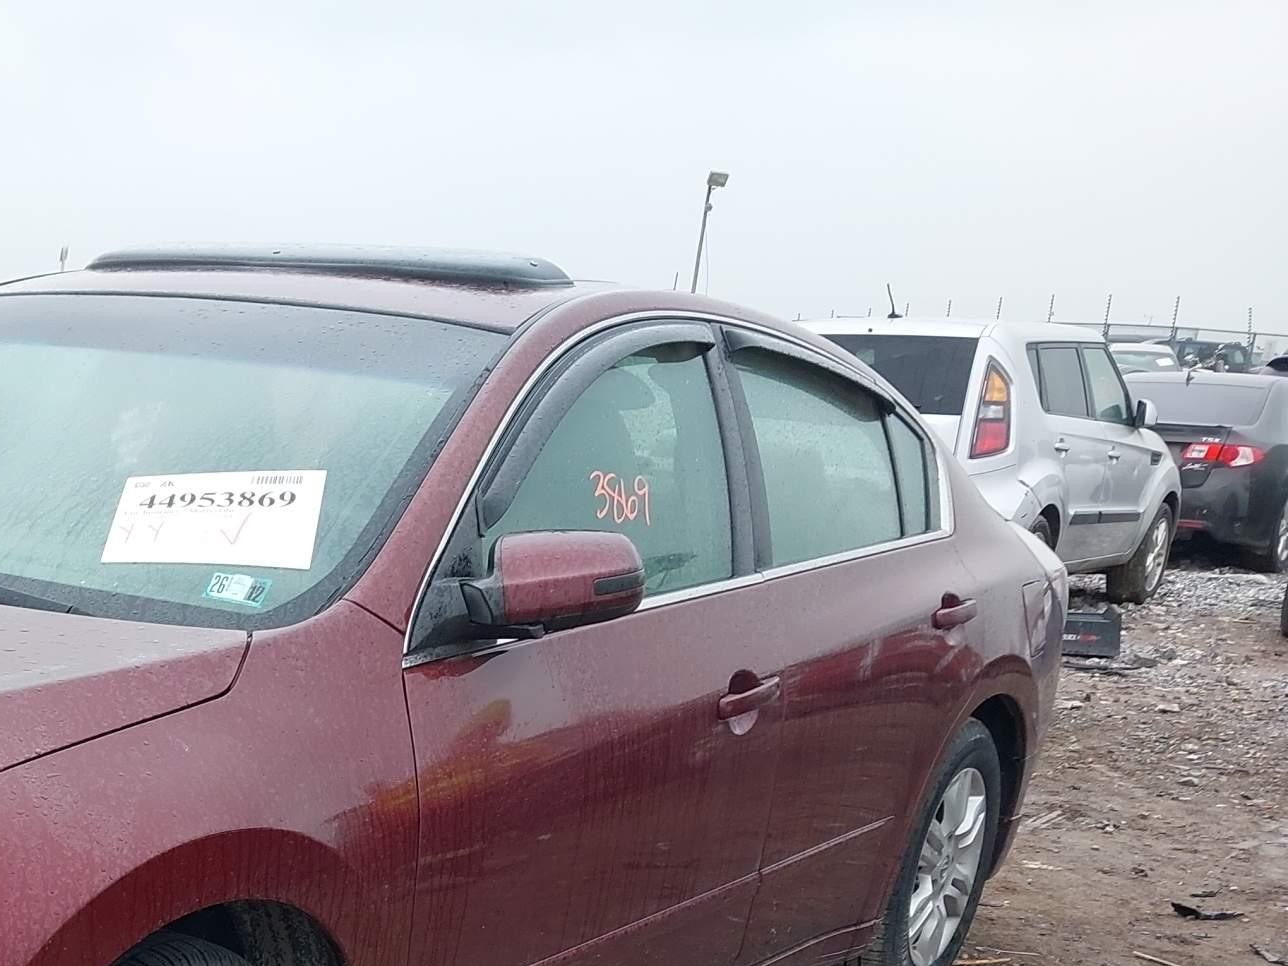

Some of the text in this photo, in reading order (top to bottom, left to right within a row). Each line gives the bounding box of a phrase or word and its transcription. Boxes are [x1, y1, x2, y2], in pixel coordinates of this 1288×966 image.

[138, 490, 298, 509] 44953869
[590, 470, 650, 526] 3869
[209, 574, 230, 594] 26
